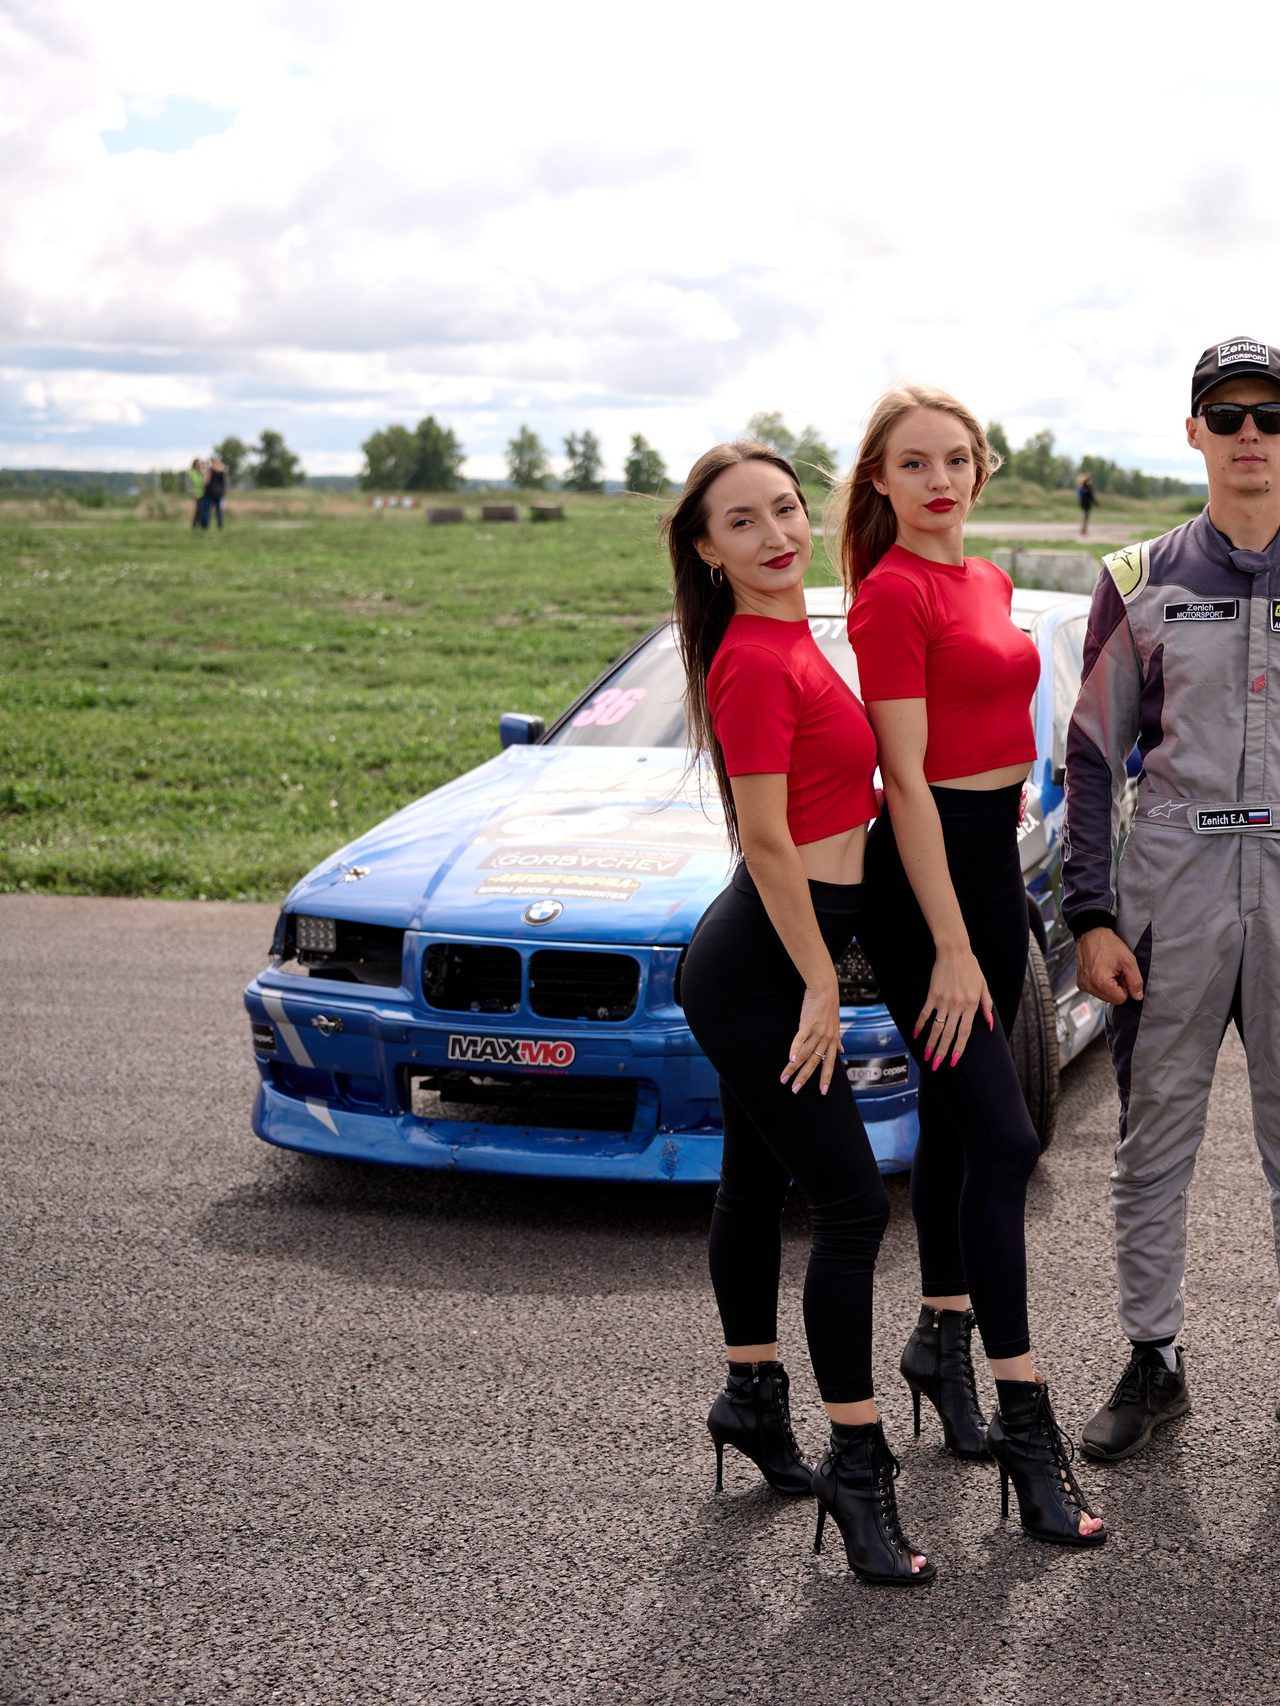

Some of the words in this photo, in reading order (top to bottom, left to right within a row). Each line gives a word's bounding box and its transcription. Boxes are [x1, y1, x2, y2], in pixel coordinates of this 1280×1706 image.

[1221, 342, 1266, 357] Zenich
[1221, 353, 1267, 364] MOTORSPORT
[1187, 603, 1214, 612] Zenich
[1176, 610, 1225, 619] MOTORSPORT
[571, 687, 648, 728] 36
[1201, 813, 1229, 826] Zenich
[1230, 812, 1248, 825] E.A.
